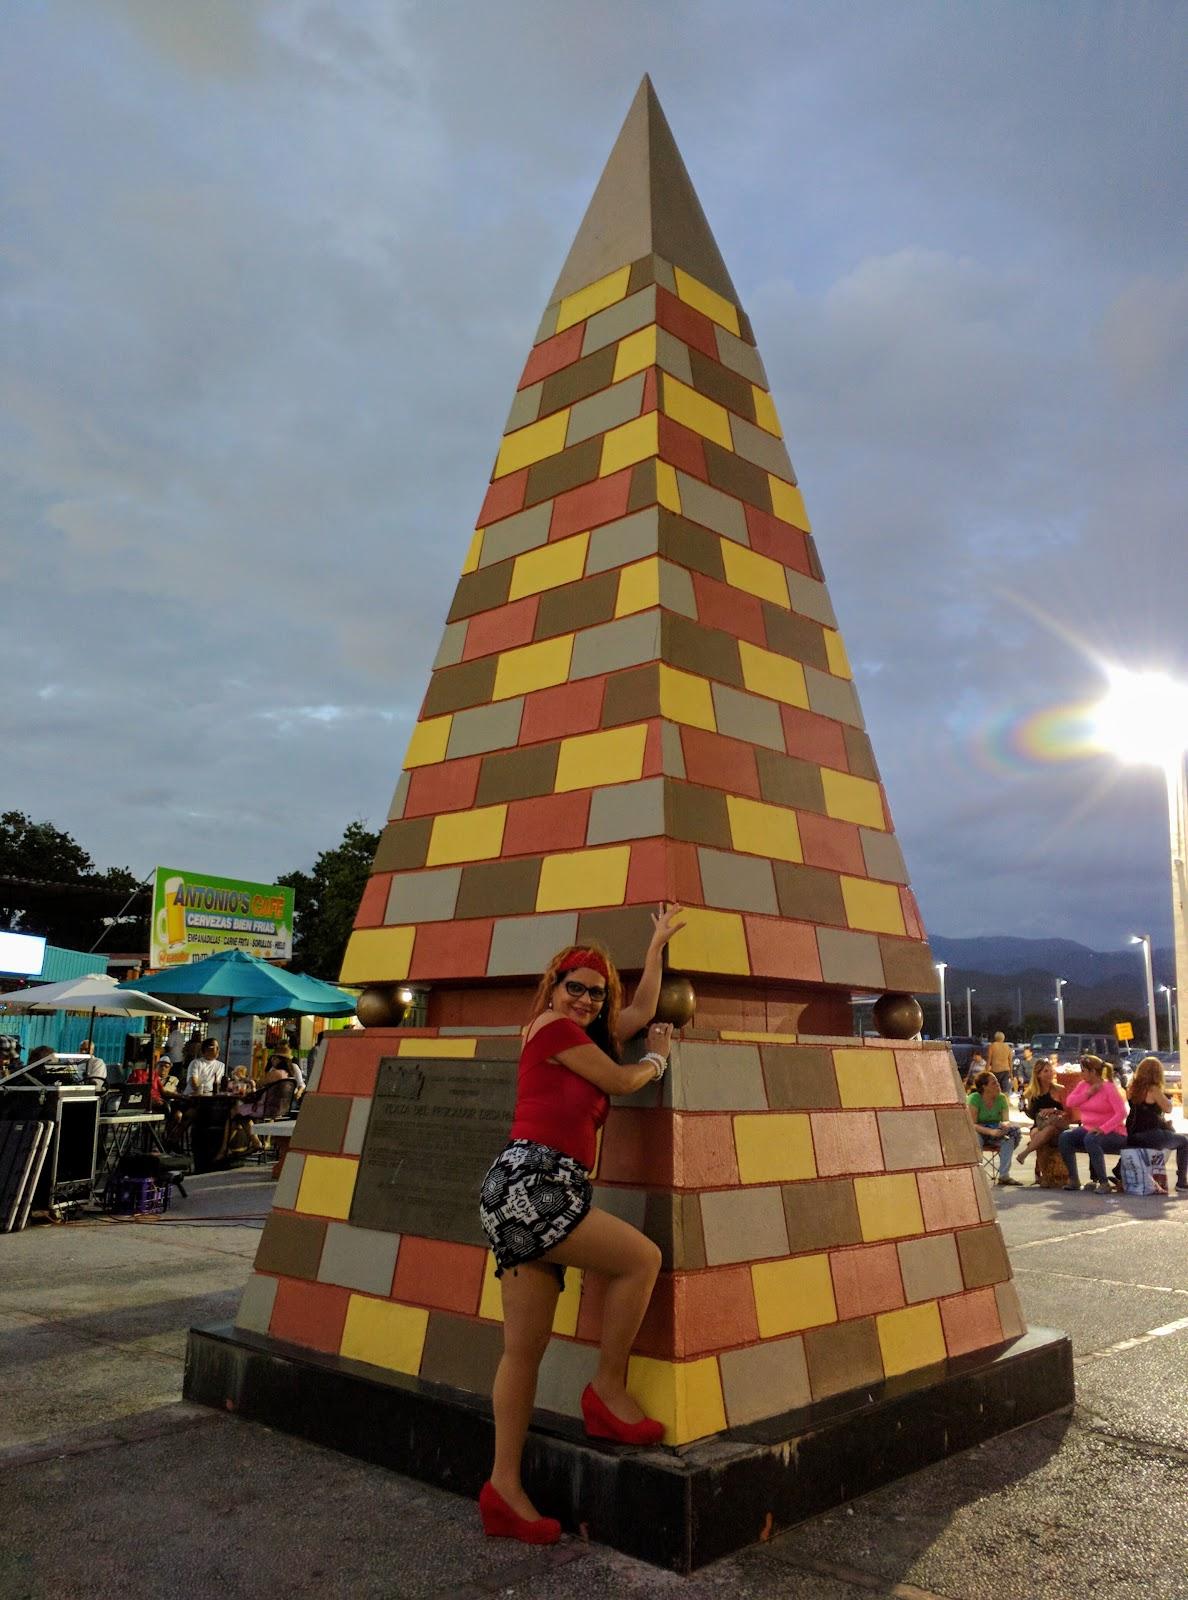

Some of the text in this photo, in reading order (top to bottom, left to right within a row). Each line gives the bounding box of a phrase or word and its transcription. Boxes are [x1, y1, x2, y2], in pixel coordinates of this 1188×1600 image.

[173, 883, 250, 914] ANTONIO'S
[187, 913, 232, 929] CERVEZAS
[233, 919, 253, 930] BIEN
[187, 933, 221, 944] EMPANADILLAS
[223, 936, 239, 945] CARNE
